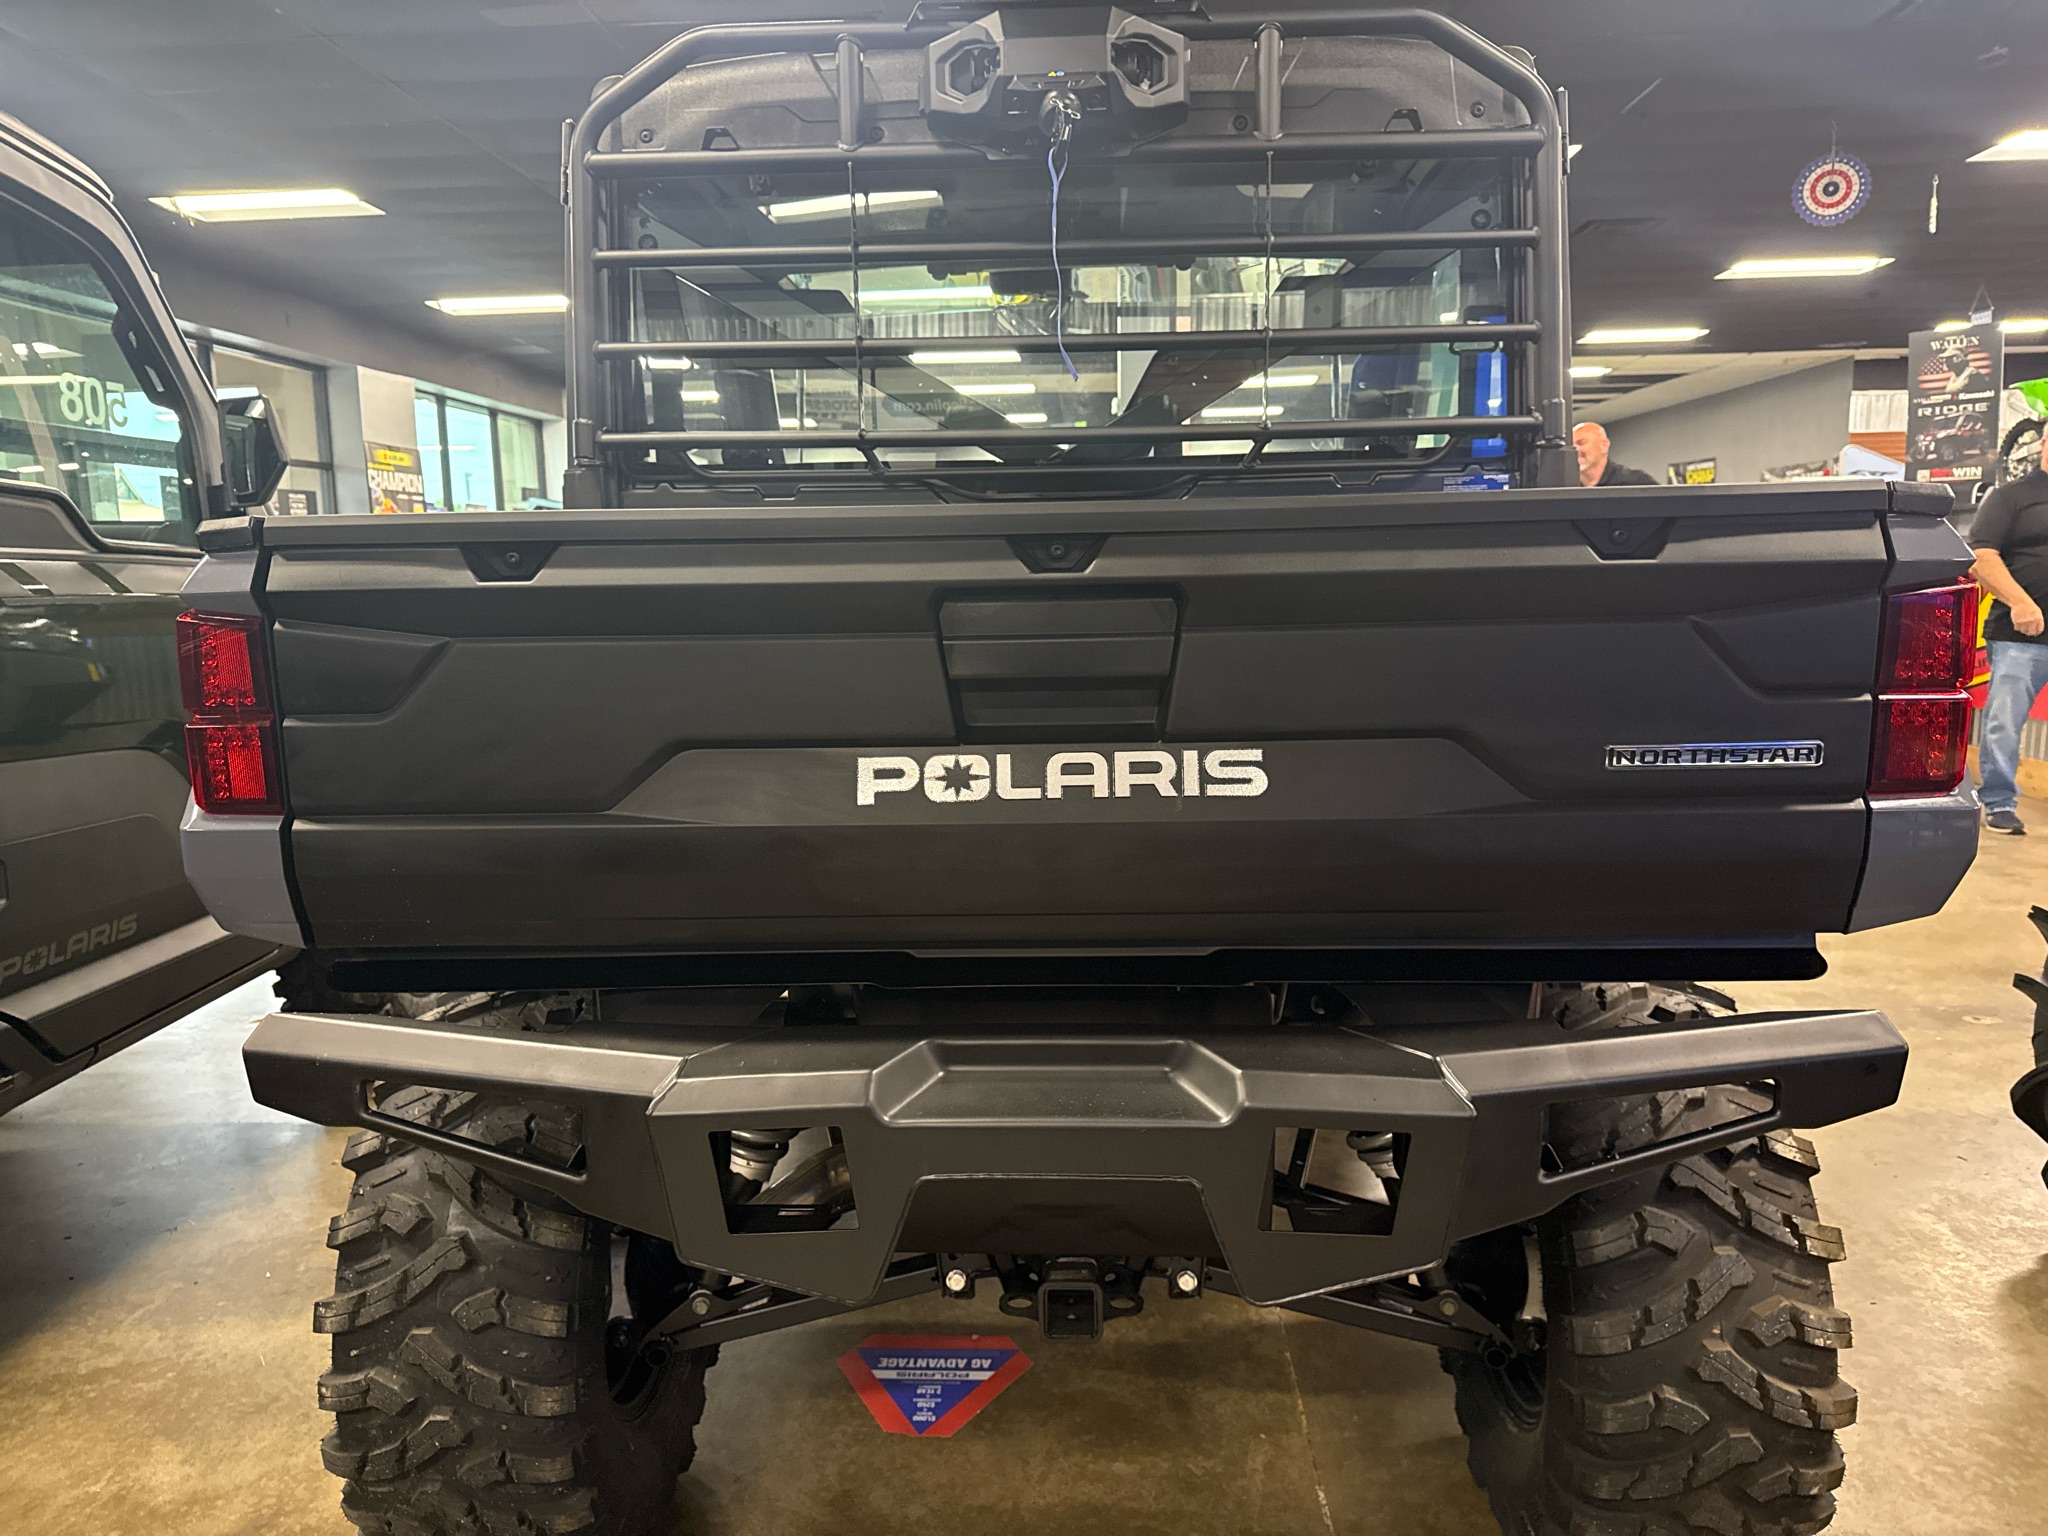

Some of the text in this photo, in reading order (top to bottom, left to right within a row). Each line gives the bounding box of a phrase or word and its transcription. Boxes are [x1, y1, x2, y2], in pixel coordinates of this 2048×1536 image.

[367, 468, 424, 494] CHAMPION
[1952, 466, 1982, 477] WIN
[1614, 746, 1817, 766] NORTHSTAR
[856, 749, 1270, 806] POLARIS
[0, 913, 138, 985] POLARIS
[878, 1356, 992, 1369] AG ADVANTAGE
[896, 1371, 970, 1379] POLARIS
